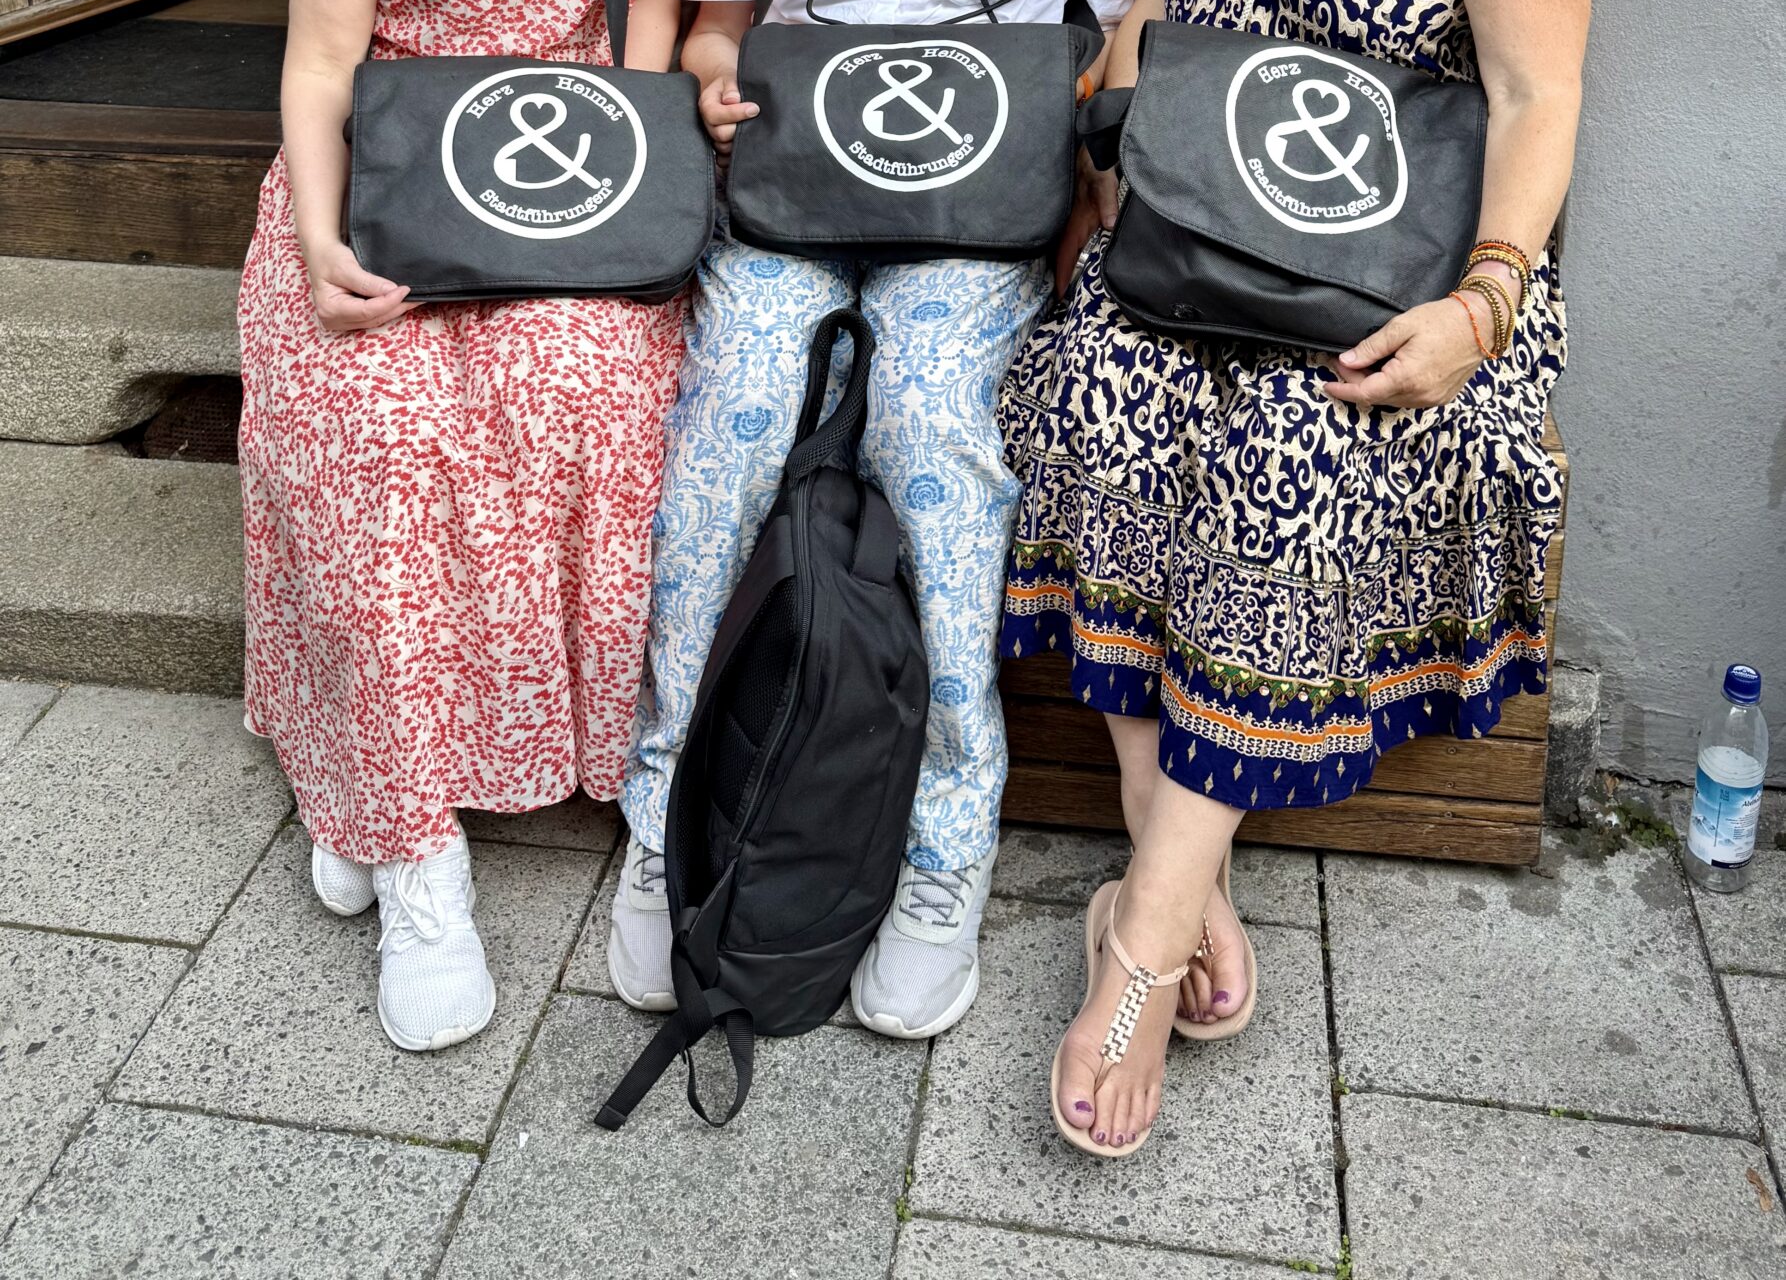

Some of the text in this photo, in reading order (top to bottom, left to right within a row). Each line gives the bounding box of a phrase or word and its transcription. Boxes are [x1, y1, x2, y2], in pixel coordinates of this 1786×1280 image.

[838, 52, 883, 76] Herz
[921, 47, 986, 80] Heimat
[1257, 62, 1302, 84] Herz
[466, 84, 515, 119] Herz
[555, 76, 624, 122] Heimat
